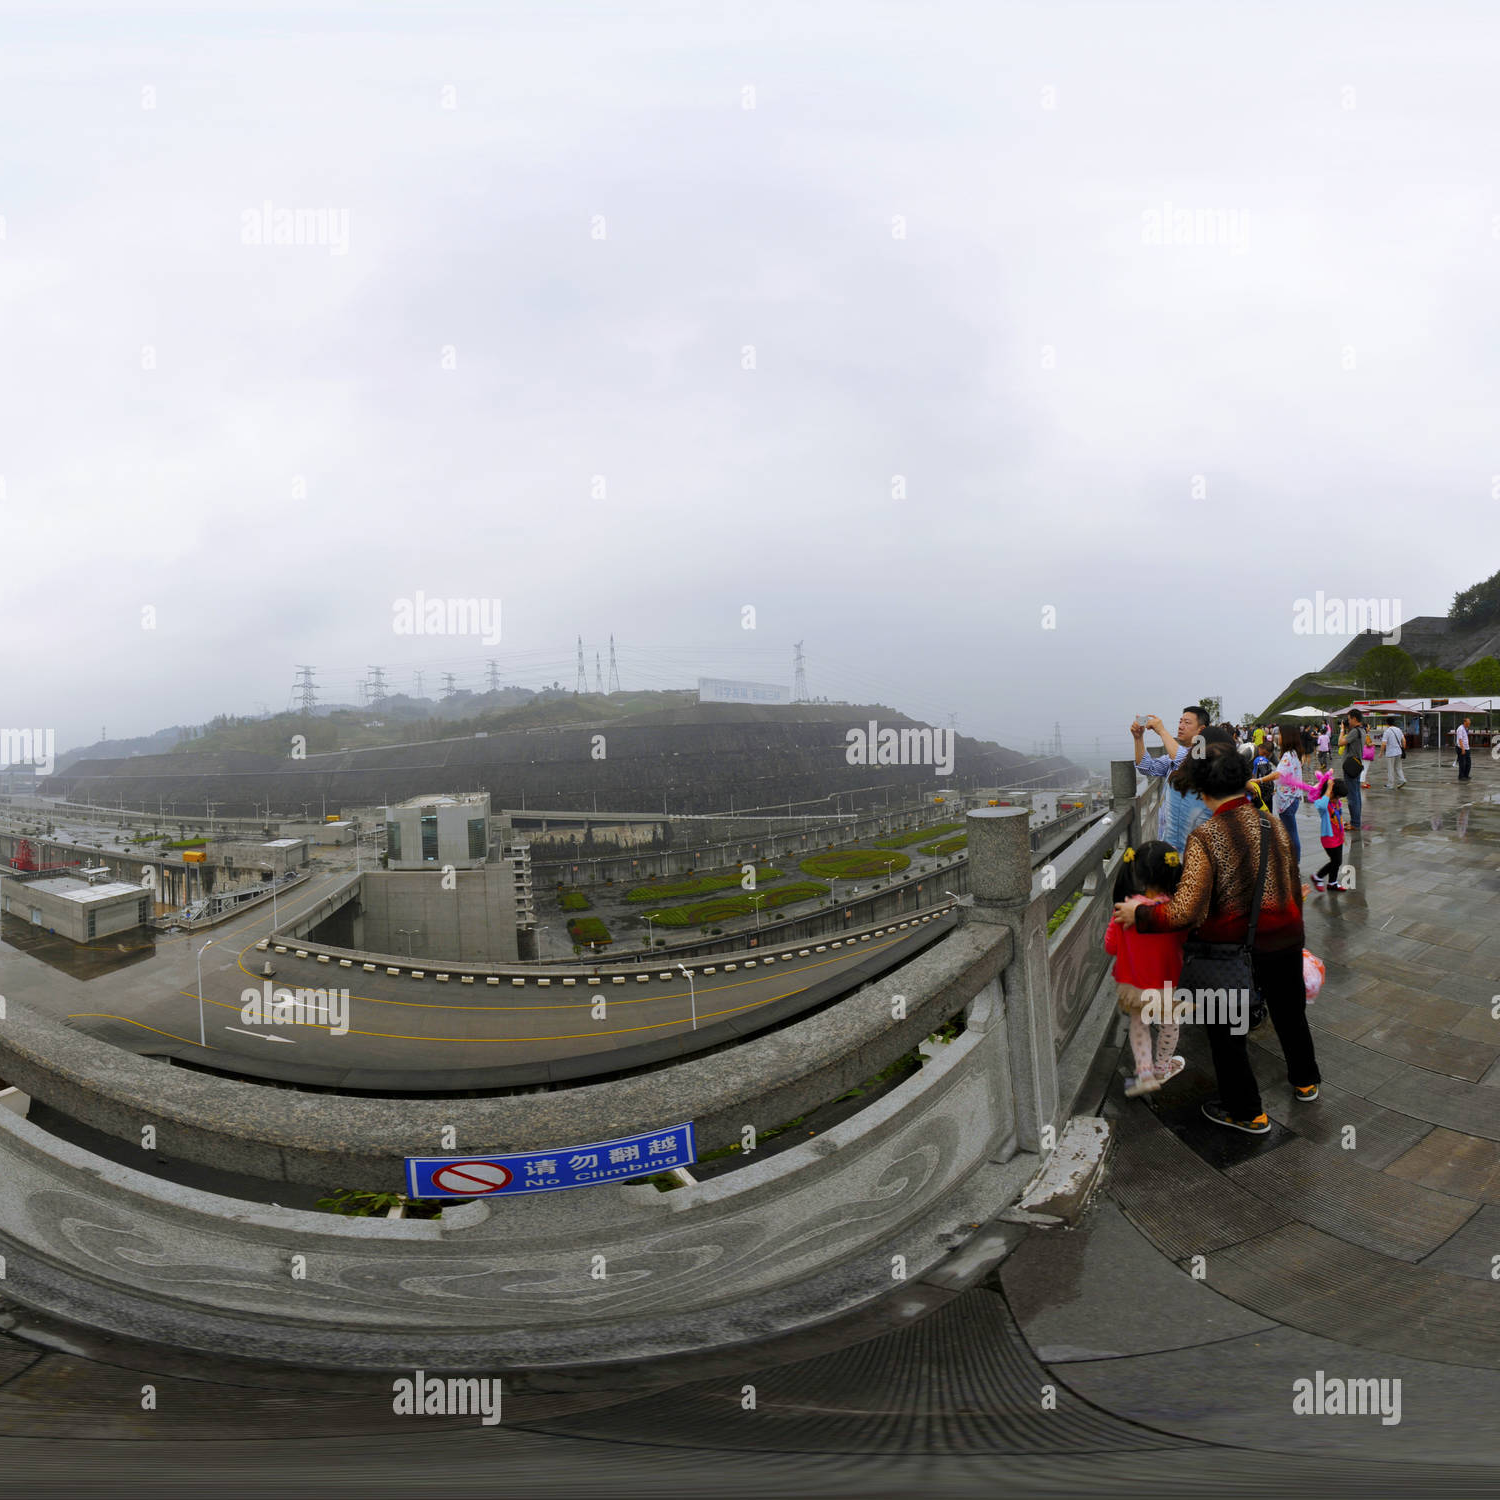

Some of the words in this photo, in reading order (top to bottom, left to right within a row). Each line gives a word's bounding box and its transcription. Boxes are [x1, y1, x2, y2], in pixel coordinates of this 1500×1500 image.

[523, 1135, 678, 1178] 请勿翻越
[525, 1175, 560, 1188] No
[575, 1154, 678, 1182] Climbing
